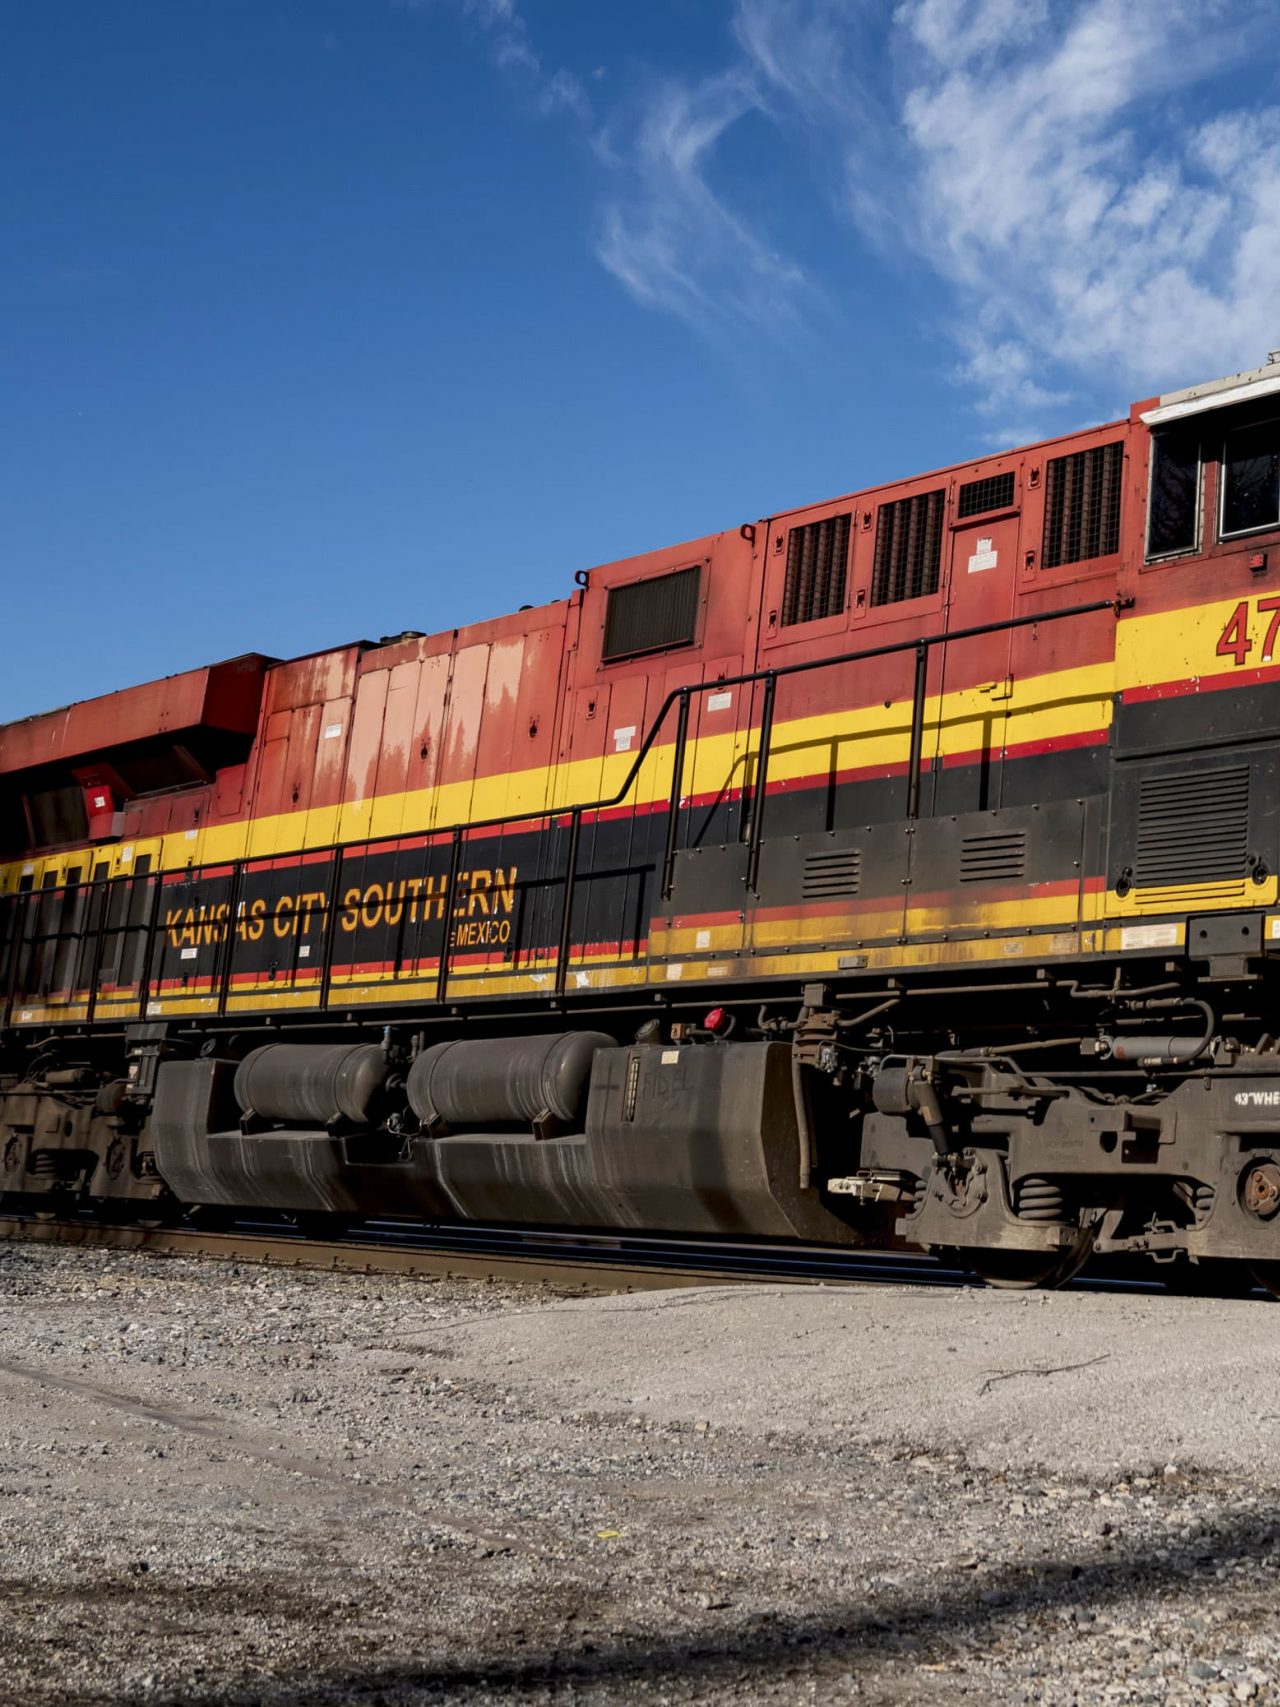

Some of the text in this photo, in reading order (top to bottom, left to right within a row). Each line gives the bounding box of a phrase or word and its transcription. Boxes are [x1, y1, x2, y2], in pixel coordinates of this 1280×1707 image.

[166, 898, 266, 948] KANSAS
[342, 866, 518, 932] SOUTHERN
[456, 919, 511, 946] MEXICO
